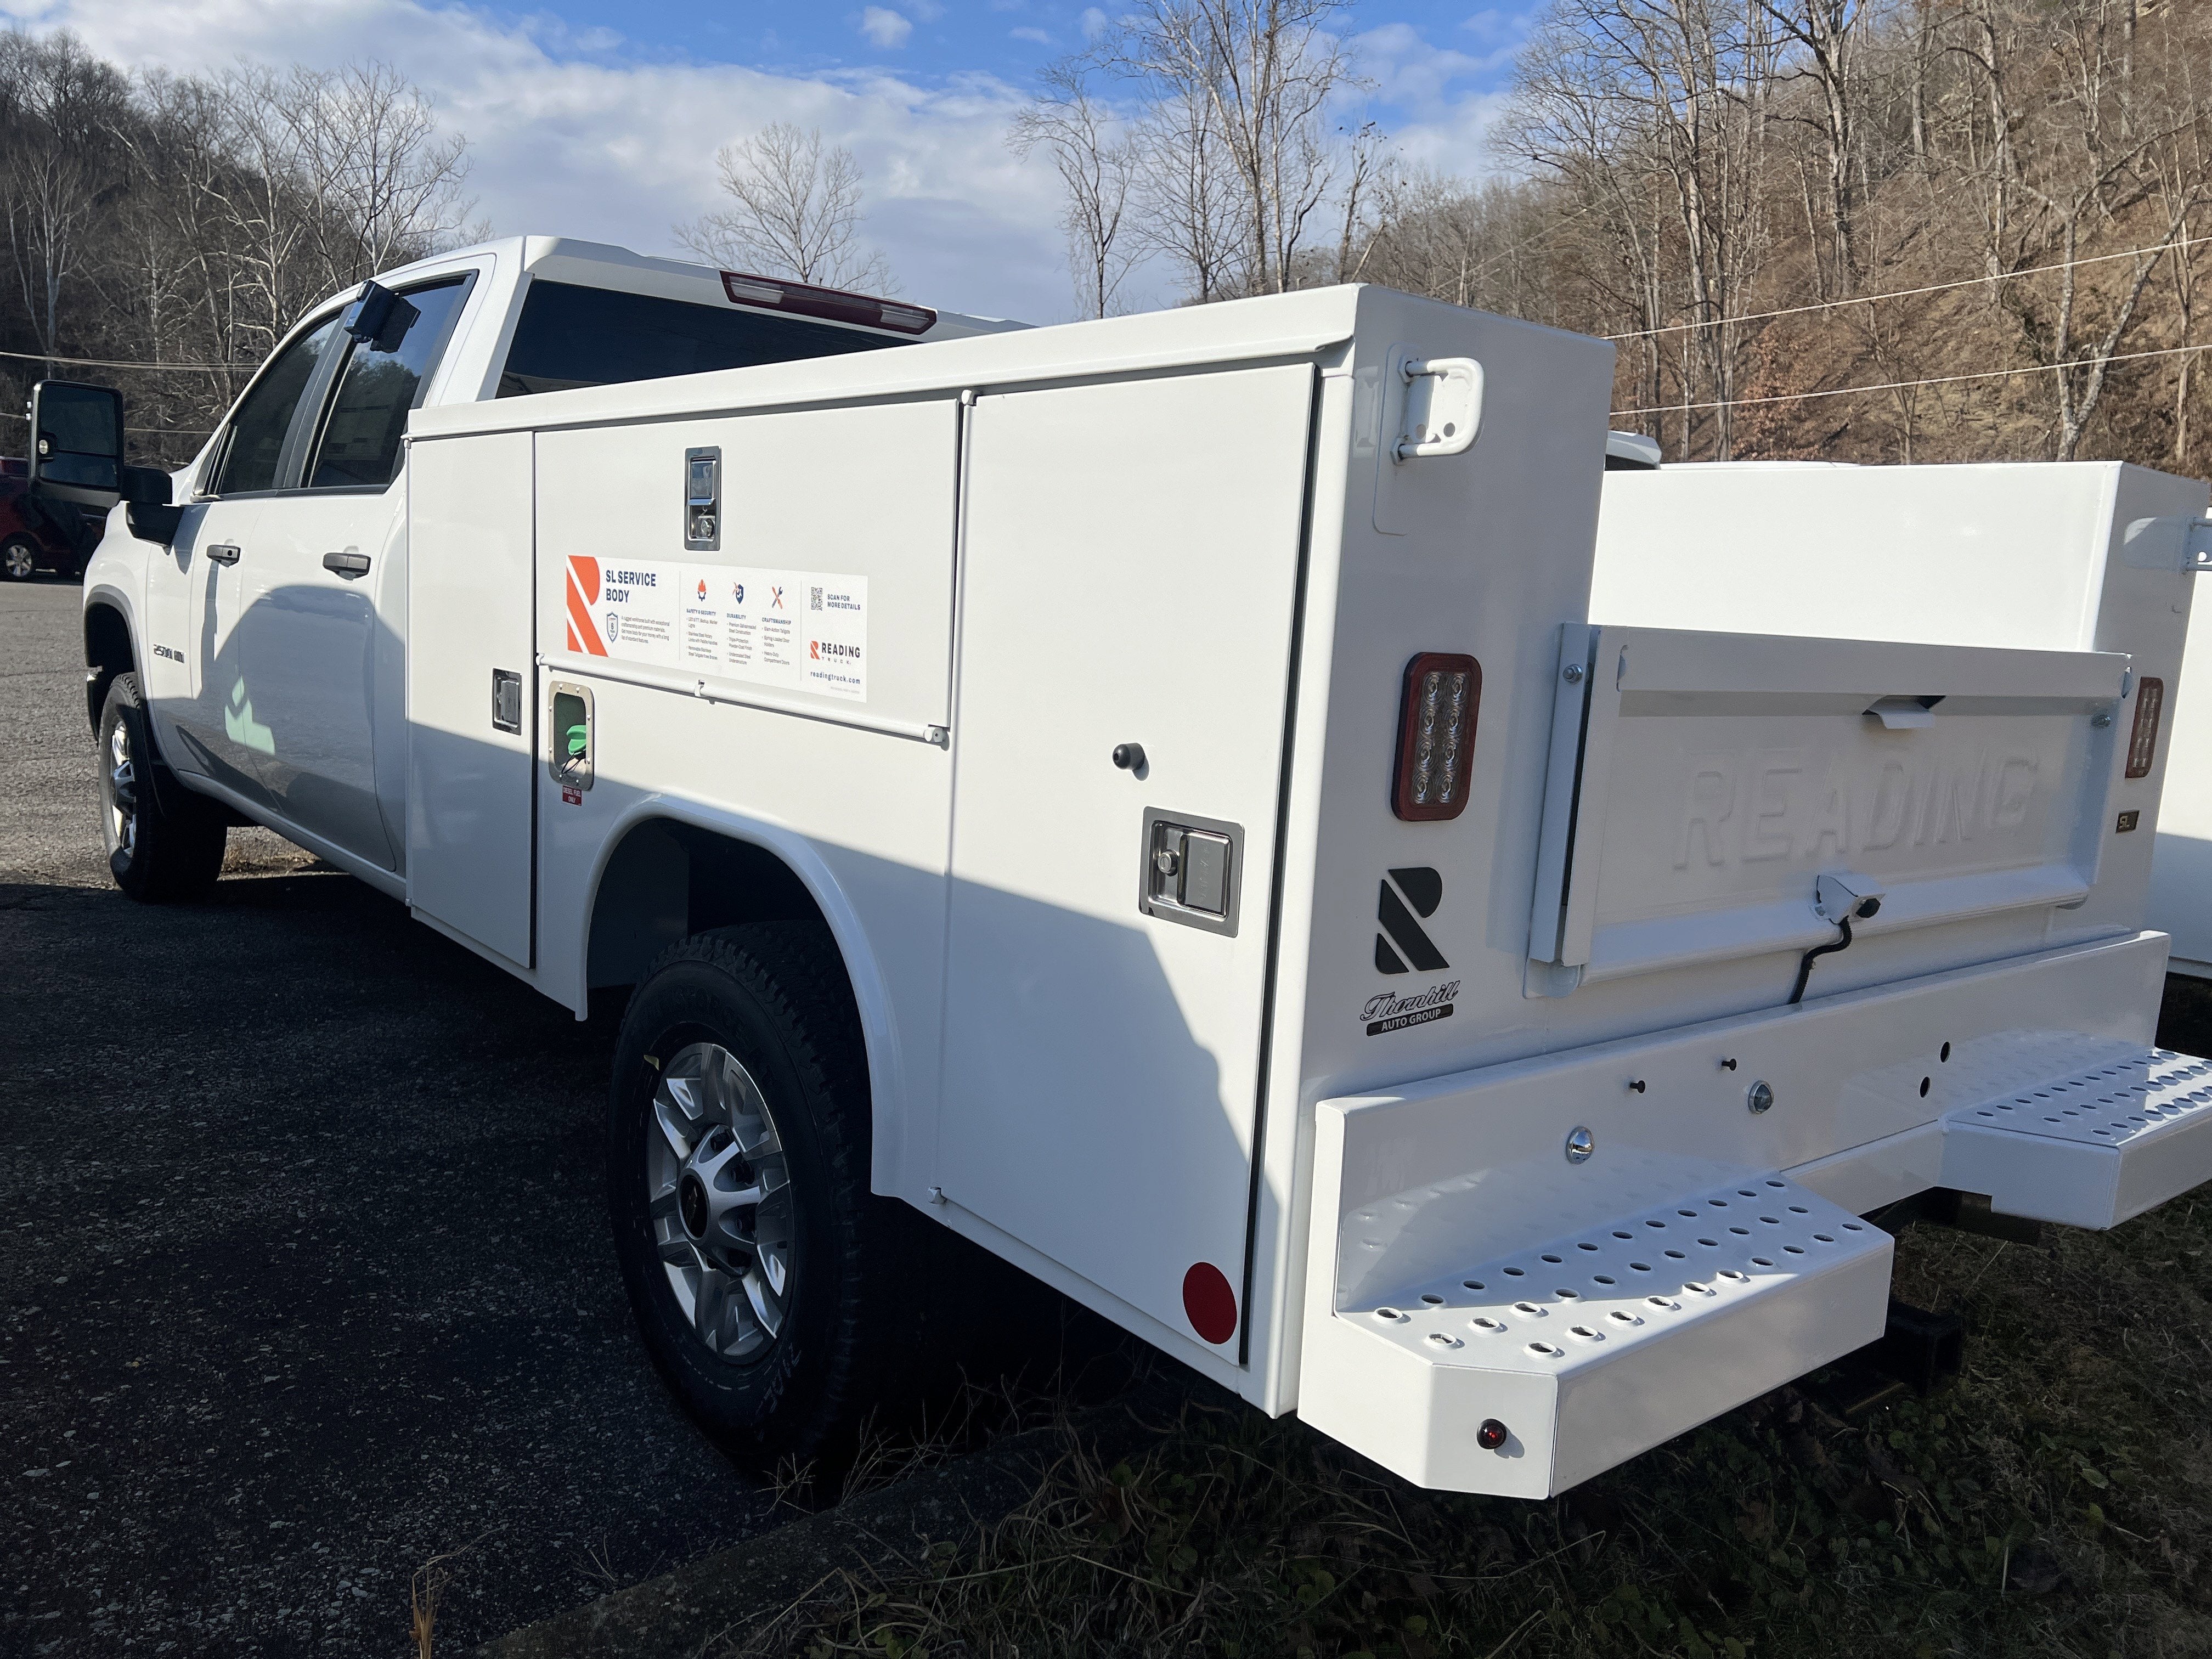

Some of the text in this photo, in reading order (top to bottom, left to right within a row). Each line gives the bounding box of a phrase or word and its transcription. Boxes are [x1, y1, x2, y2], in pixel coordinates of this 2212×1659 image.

[606, 570, 656, 587] SL SERVICE
[606, 588, 630, 603] BODY
[841, 602, 860, 610] DETAILS
[822, 642, 860, 658] READING
[810, 671, 860, 685] readingtruck.com
[1672, 747, 2042, 871] READING
[1360, 980, 1460, 1021] Thornhill
[1381, 1008, 1441, 1031] AUTO GROUP
